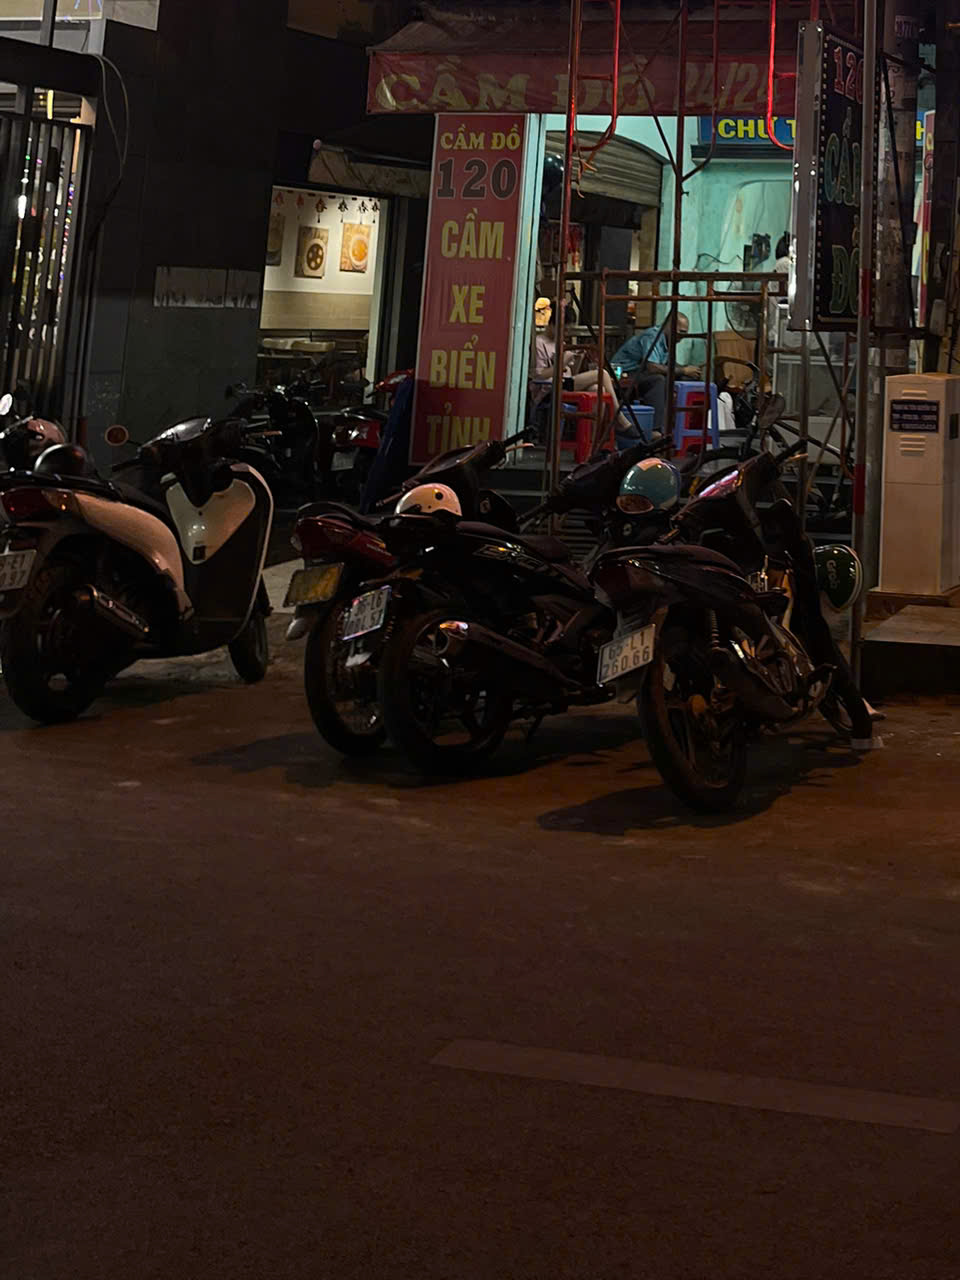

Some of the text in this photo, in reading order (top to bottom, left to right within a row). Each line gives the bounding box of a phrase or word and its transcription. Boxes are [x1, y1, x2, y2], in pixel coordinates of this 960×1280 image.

[375, 55, 535, 112] CẦM
[440, 123, 521, 150] CẦM ĐỒ
[437, 157, 518, 200] 120
[440, 207, 505, 260] CẦM
[448, 284, 486, 324] XE
[428, 334, 497, 390] BIỂN
[426, 401, 492, 455] TỈNH
